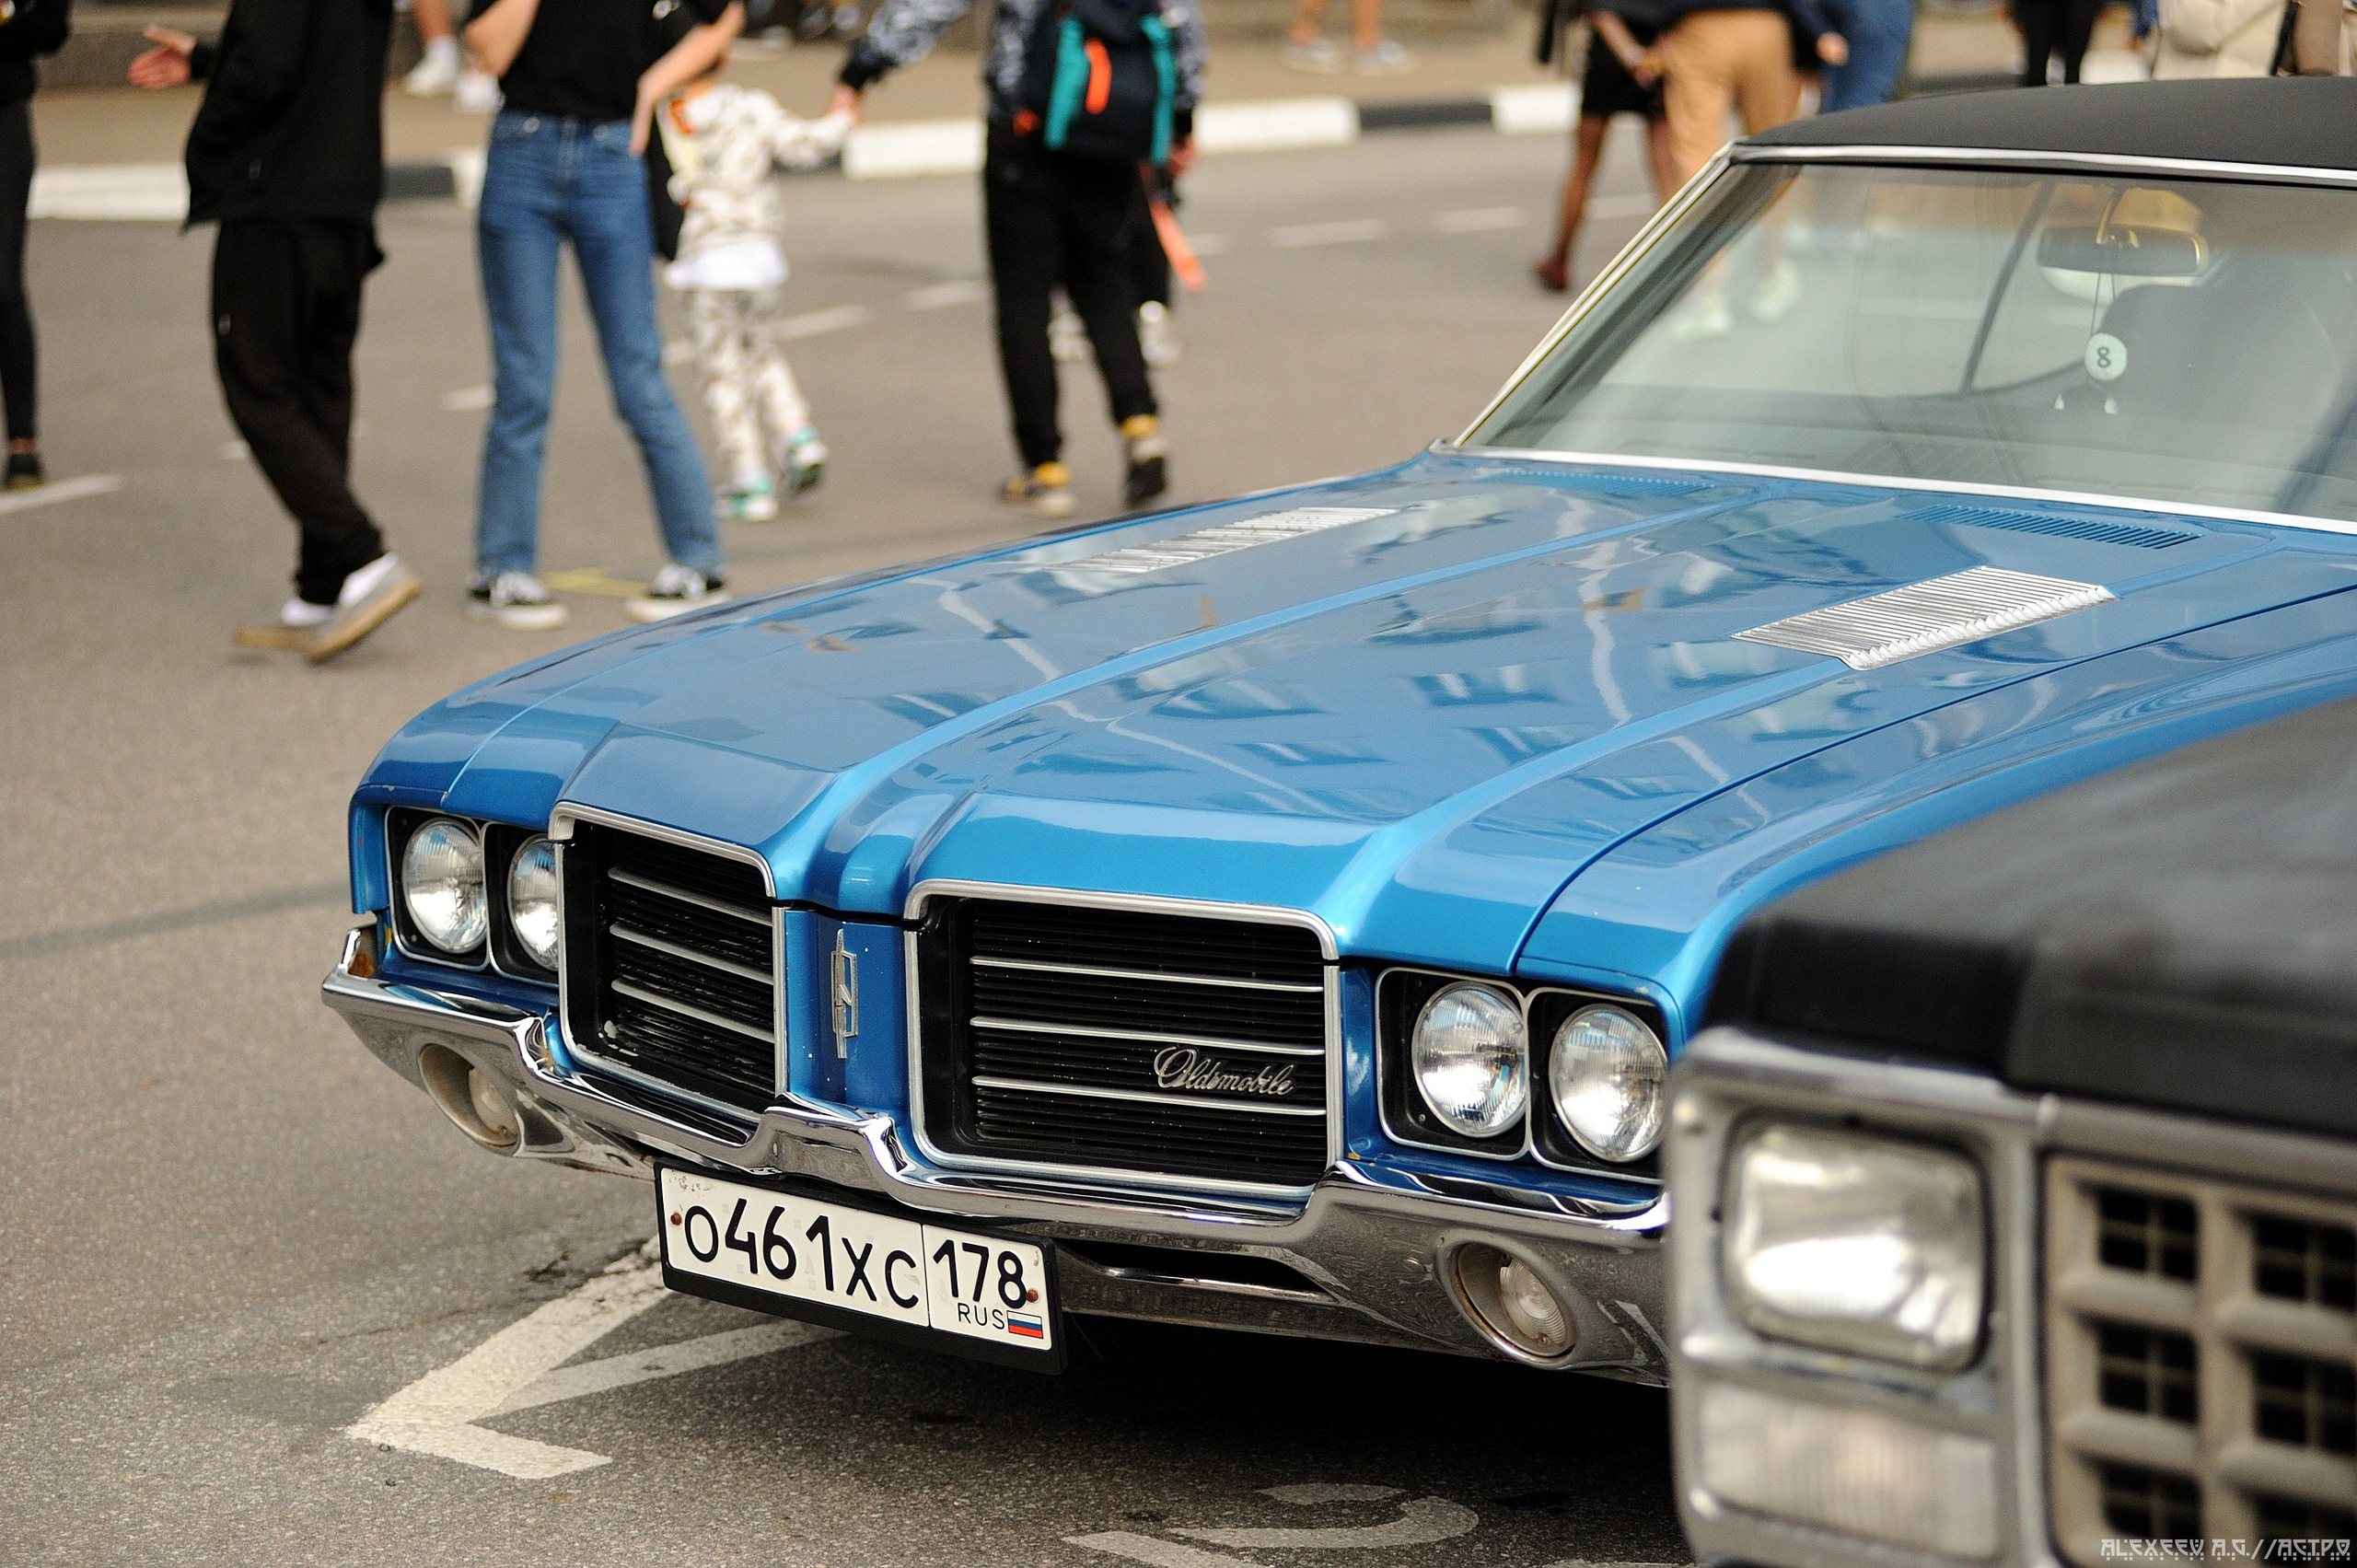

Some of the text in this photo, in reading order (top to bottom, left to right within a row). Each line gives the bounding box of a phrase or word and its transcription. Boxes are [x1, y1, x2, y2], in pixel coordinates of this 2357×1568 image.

[2096, 346, 2111, 368] 8
[1154, 1046, 1295, 1096] Oldsmobile
[933, 1238, 1028, 1309] 178
[958, 1303, 1005, 1330] RUS
